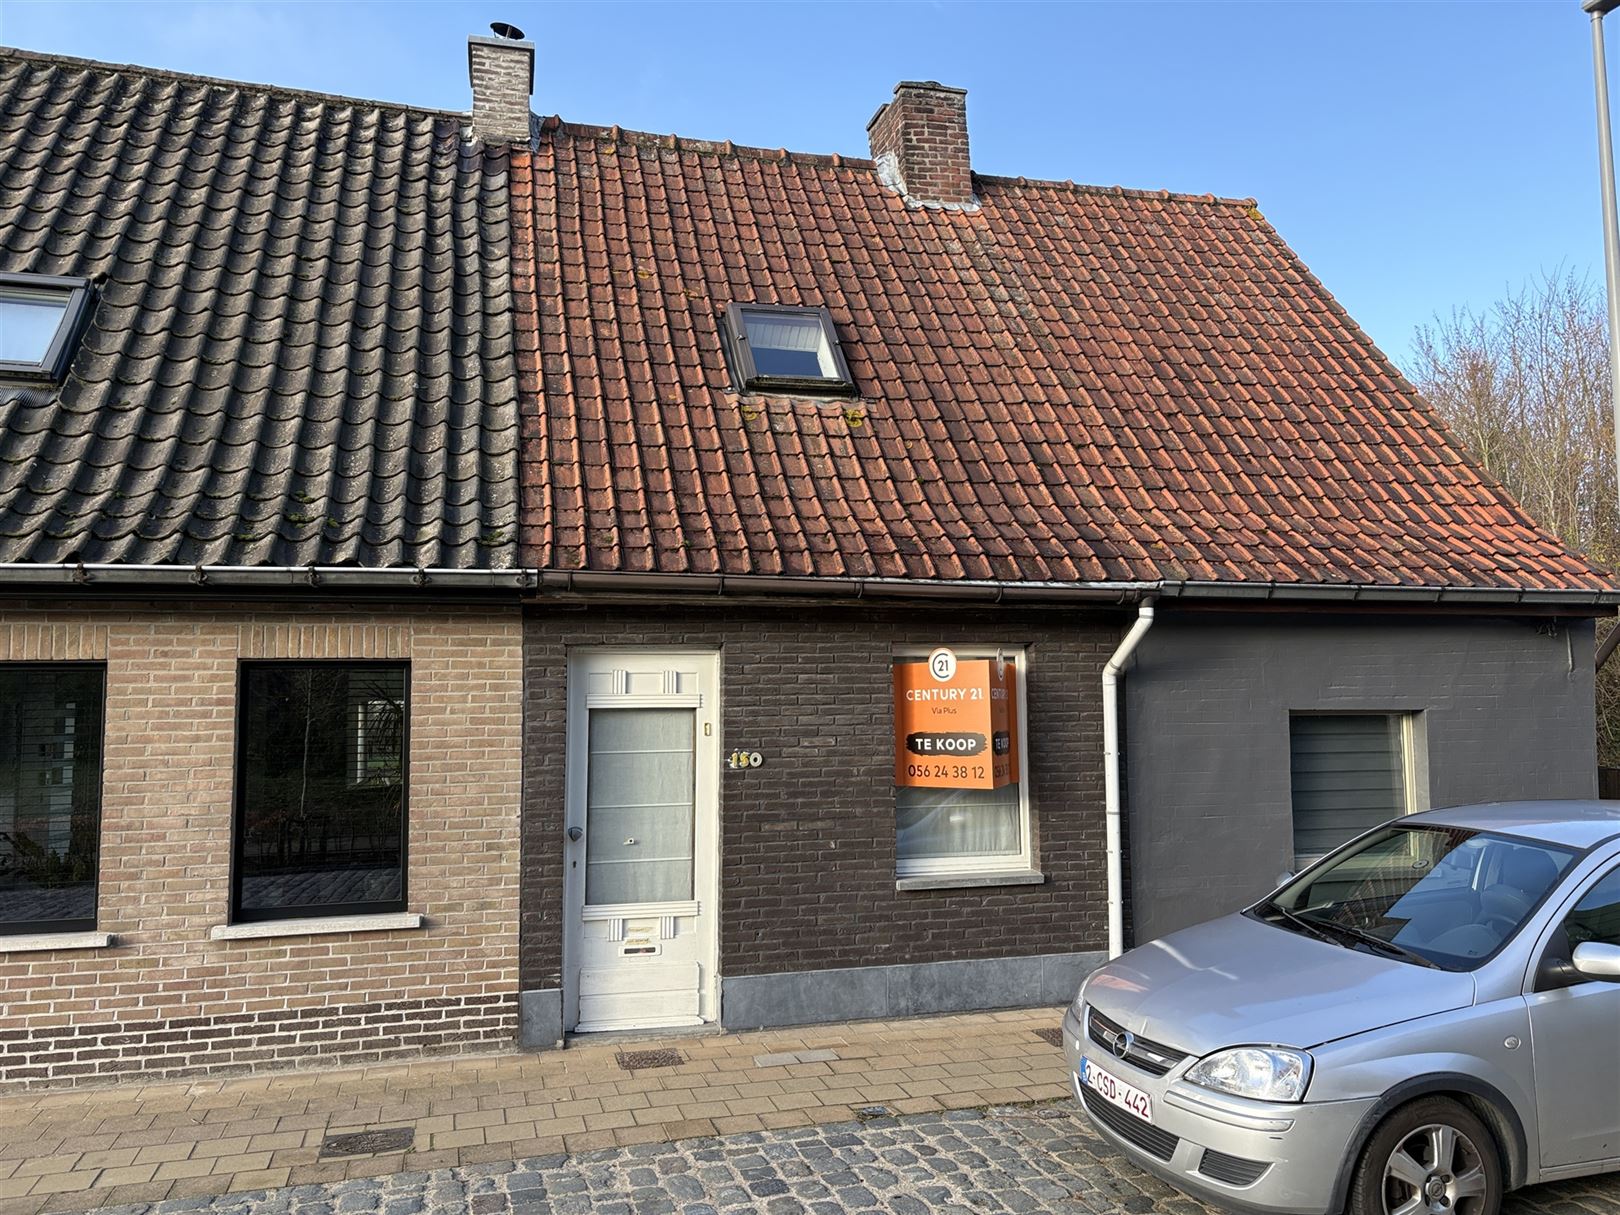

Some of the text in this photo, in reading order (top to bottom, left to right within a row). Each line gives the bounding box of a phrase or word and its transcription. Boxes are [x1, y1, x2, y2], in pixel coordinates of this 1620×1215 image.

[937, 660, 949, 672] 21
[906, 688, 966, 701] CENTURY
[970, 687, 984, 700] 21
[931, 706, 957, 715] Via Plus
[915, 738, 976, 751] TE KOOP
[908, 764, 931, 778] 056
[934, 765, 948, 778] 24
[952, 765, 968, 779] 38
[972, 766, 985, 779] 12
